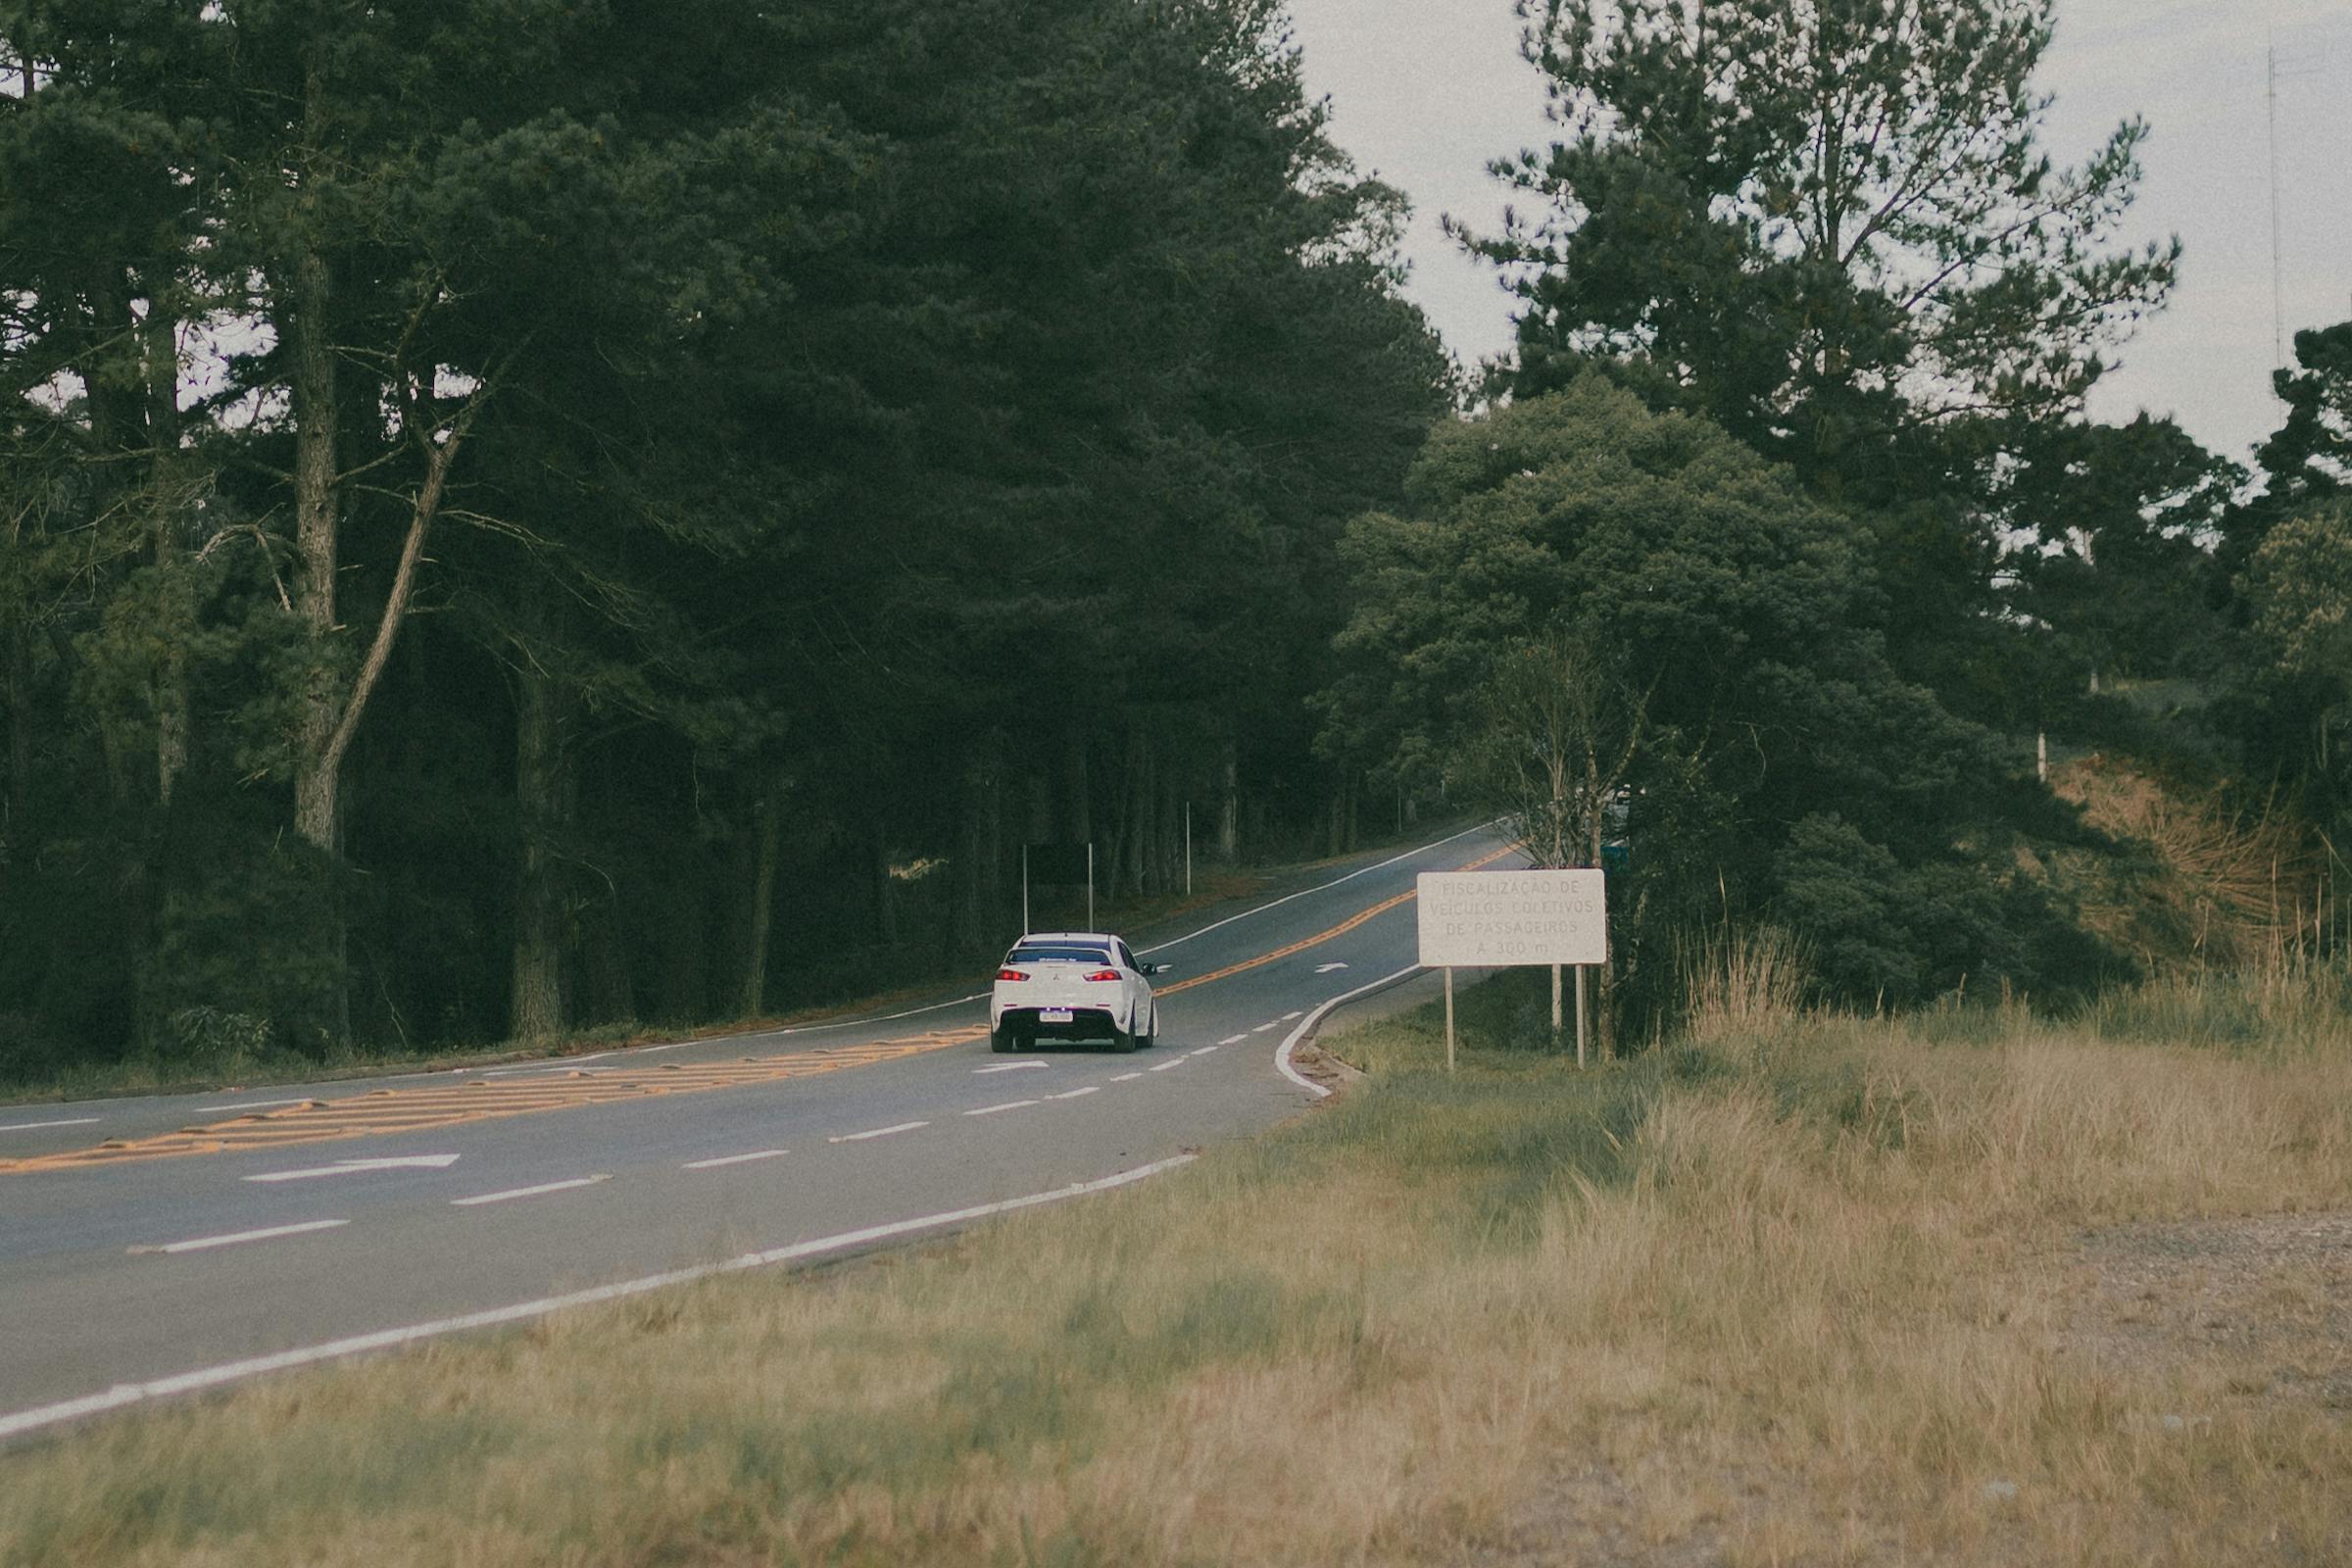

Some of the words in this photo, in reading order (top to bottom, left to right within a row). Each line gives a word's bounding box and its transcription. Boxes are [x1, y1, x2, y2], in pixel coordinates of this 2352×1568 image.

[1560, 880, 1580, 894] DE
[1512, 900, 1593, 914] COLETIVOS
[1446, 923, 1465, 936] DE
[1475, 920, 1577, 935] PASSAGEIROS
[1477, 942, 1486, 955] A
[1496, 942, 1526, 956] 300
[1536, 943, 1548, 954] m
